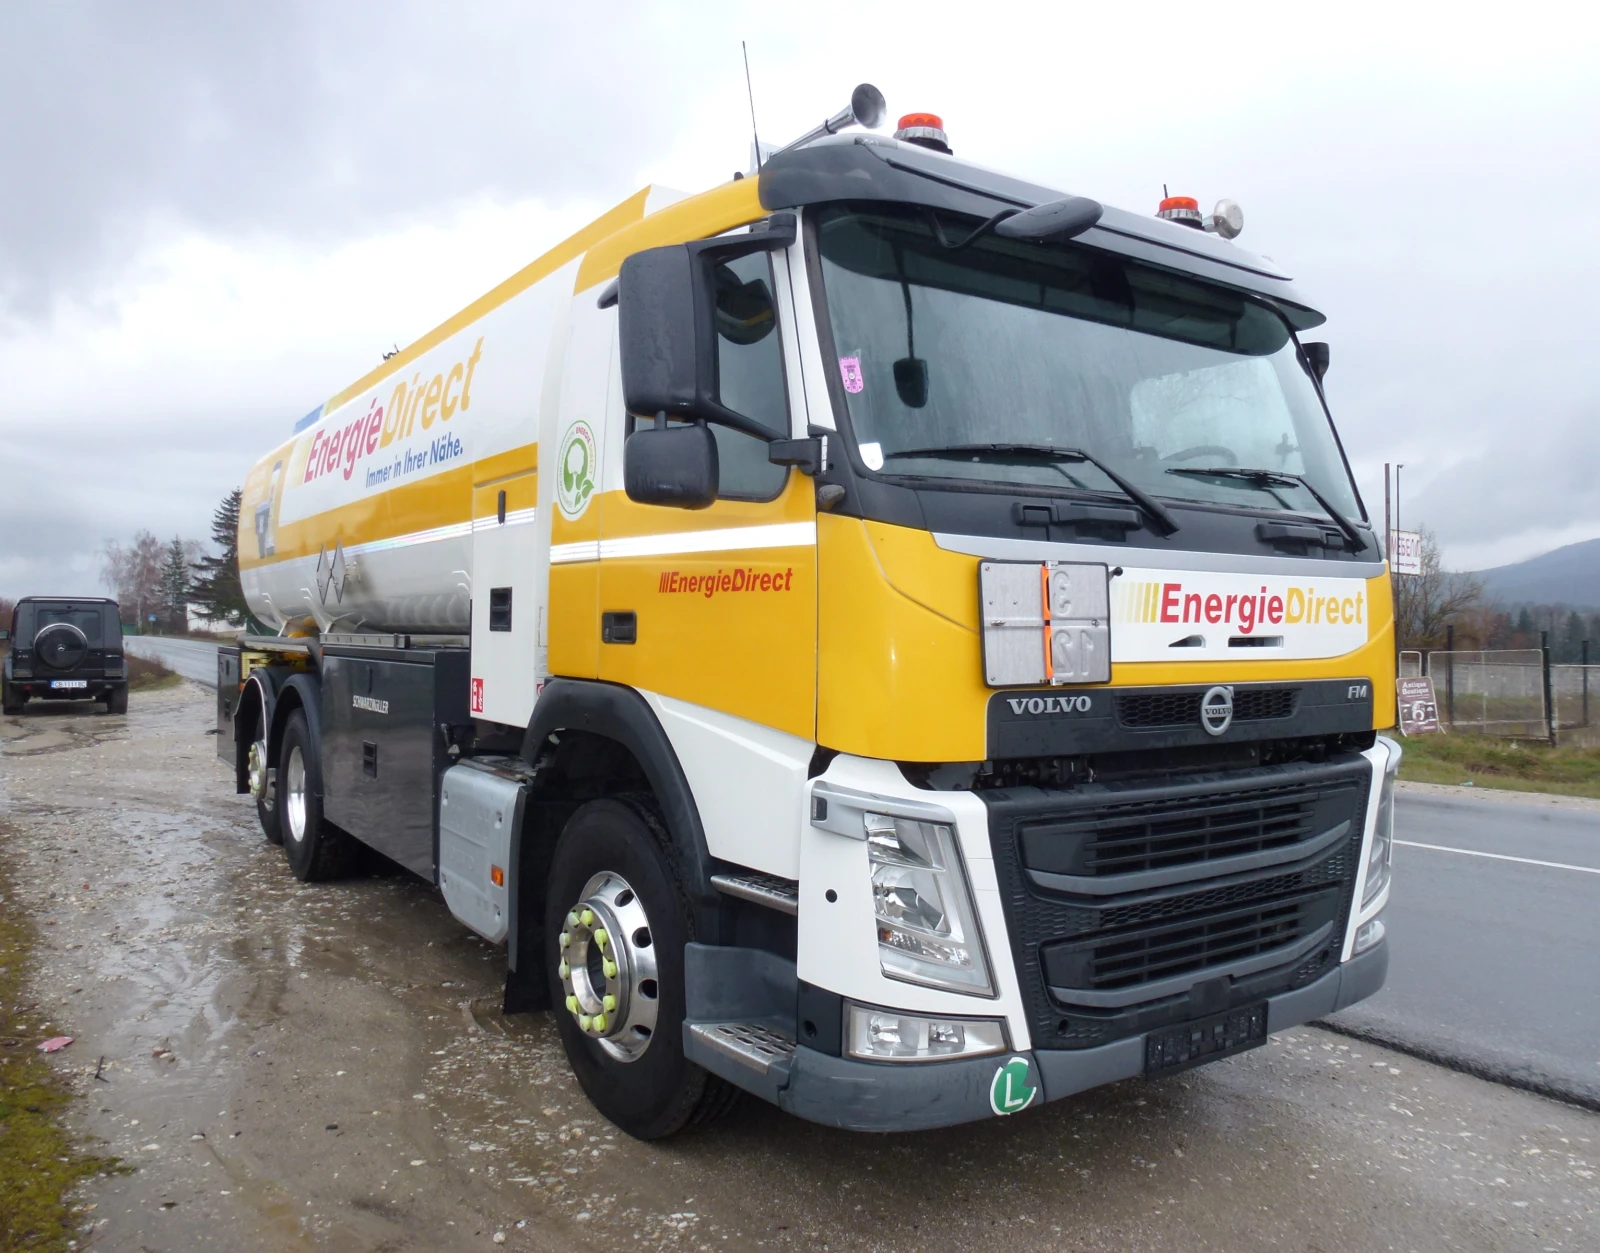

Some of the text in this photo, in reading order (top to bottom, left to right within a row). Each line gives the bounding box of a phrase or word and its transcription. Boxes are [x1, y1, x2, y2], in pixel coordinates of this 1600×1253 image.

[365, 432, 464, 489] Immer in Ihrer Nähe.
[668, 567, 793, 599] EnergieDirect
[1159, 582, 1363, 635] EnergieDirect
[1007, 695, 1092, 716] VOLVO
[1348, 685, 1367, 699] FM
[1204, 707, 1232, 715] VOLVO
[1004, 1073, 1024, 1108] L
